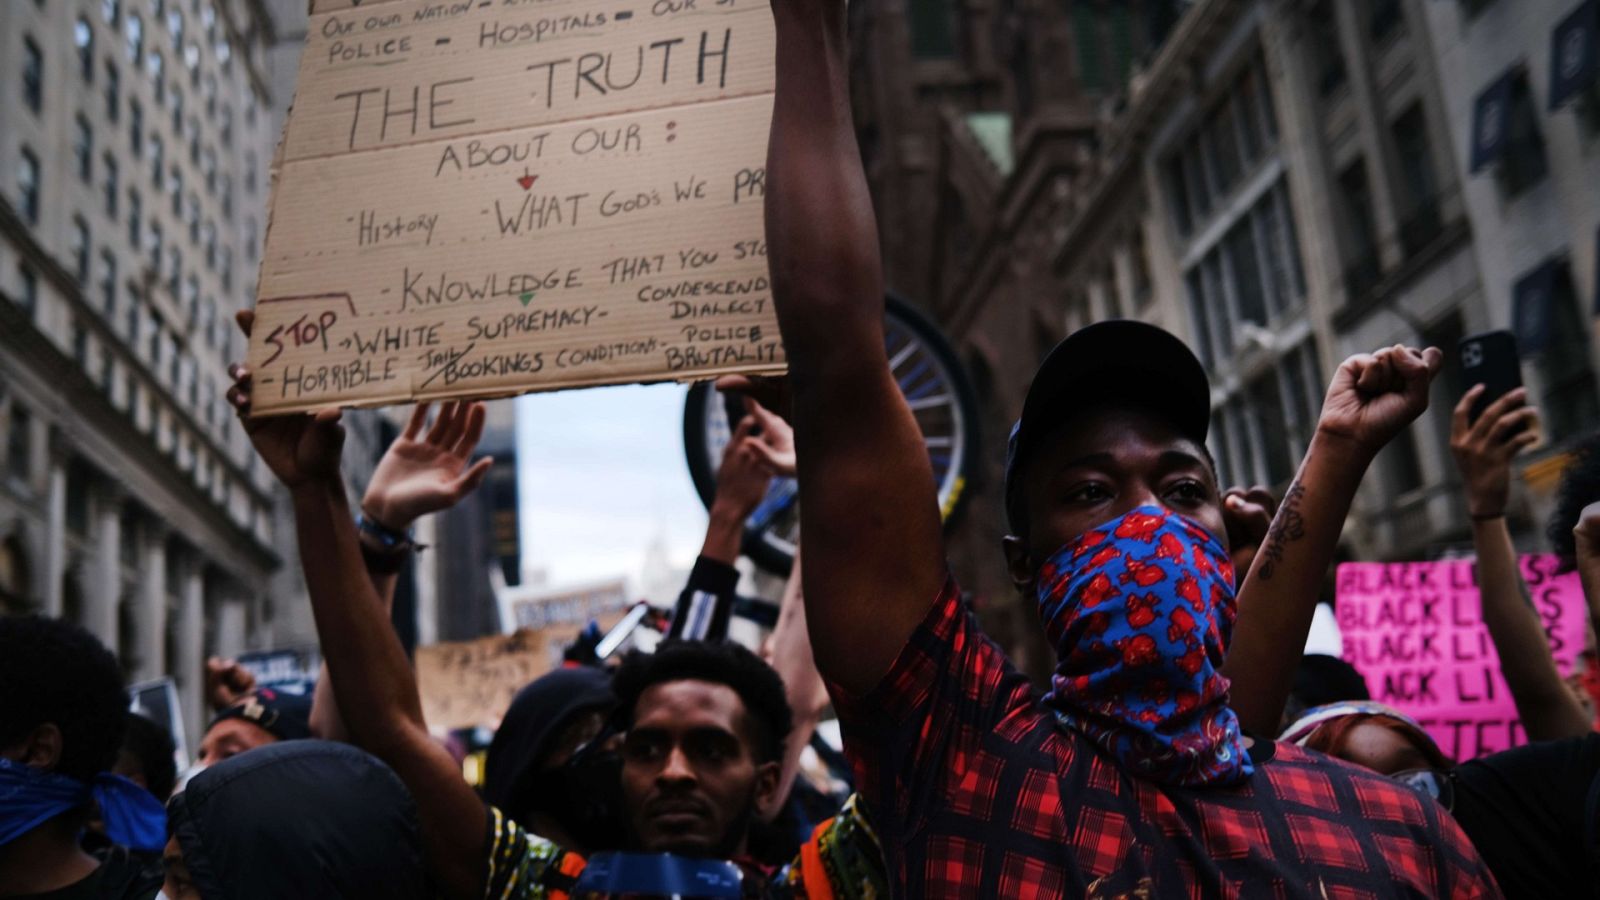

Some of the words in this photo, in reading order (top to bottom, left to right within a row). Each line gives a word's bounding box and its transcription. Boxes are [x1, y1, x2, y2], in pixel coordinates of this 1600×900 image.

[328, 36, 412, 64] POLICE
[479, 13, 607, 48] HOSPITALS
[334, 76, 475, 150] THE
[526, 28, 731, 109] TRUTH
[435, 131, 550, 177] ABOUT
[571, 123, 642, 154] OUR
[494, 191, 590, 234] WHAT
[674, 175, 707, 202] WE
[402, 267, 583, 311] KNOWLEDGE
[602, 254, 665, 284] THAT
[680, 249, 718, 270] YOU
[669, 299, 765, 320] DIALECT
[261, 311, 337, 368] STOP
[354, 322, 444, 355] WHITE
[680, 325, 762, 343] POLICE
[282, 357, 399, 398] HORRIBLE
[665, 343, 785, 371] BRUTALIT
[1340, 562, 1438, 594] BLACK
[1341, 597, 1441, 632] BLACK
[1381, 668, 1438, 704] ACK
